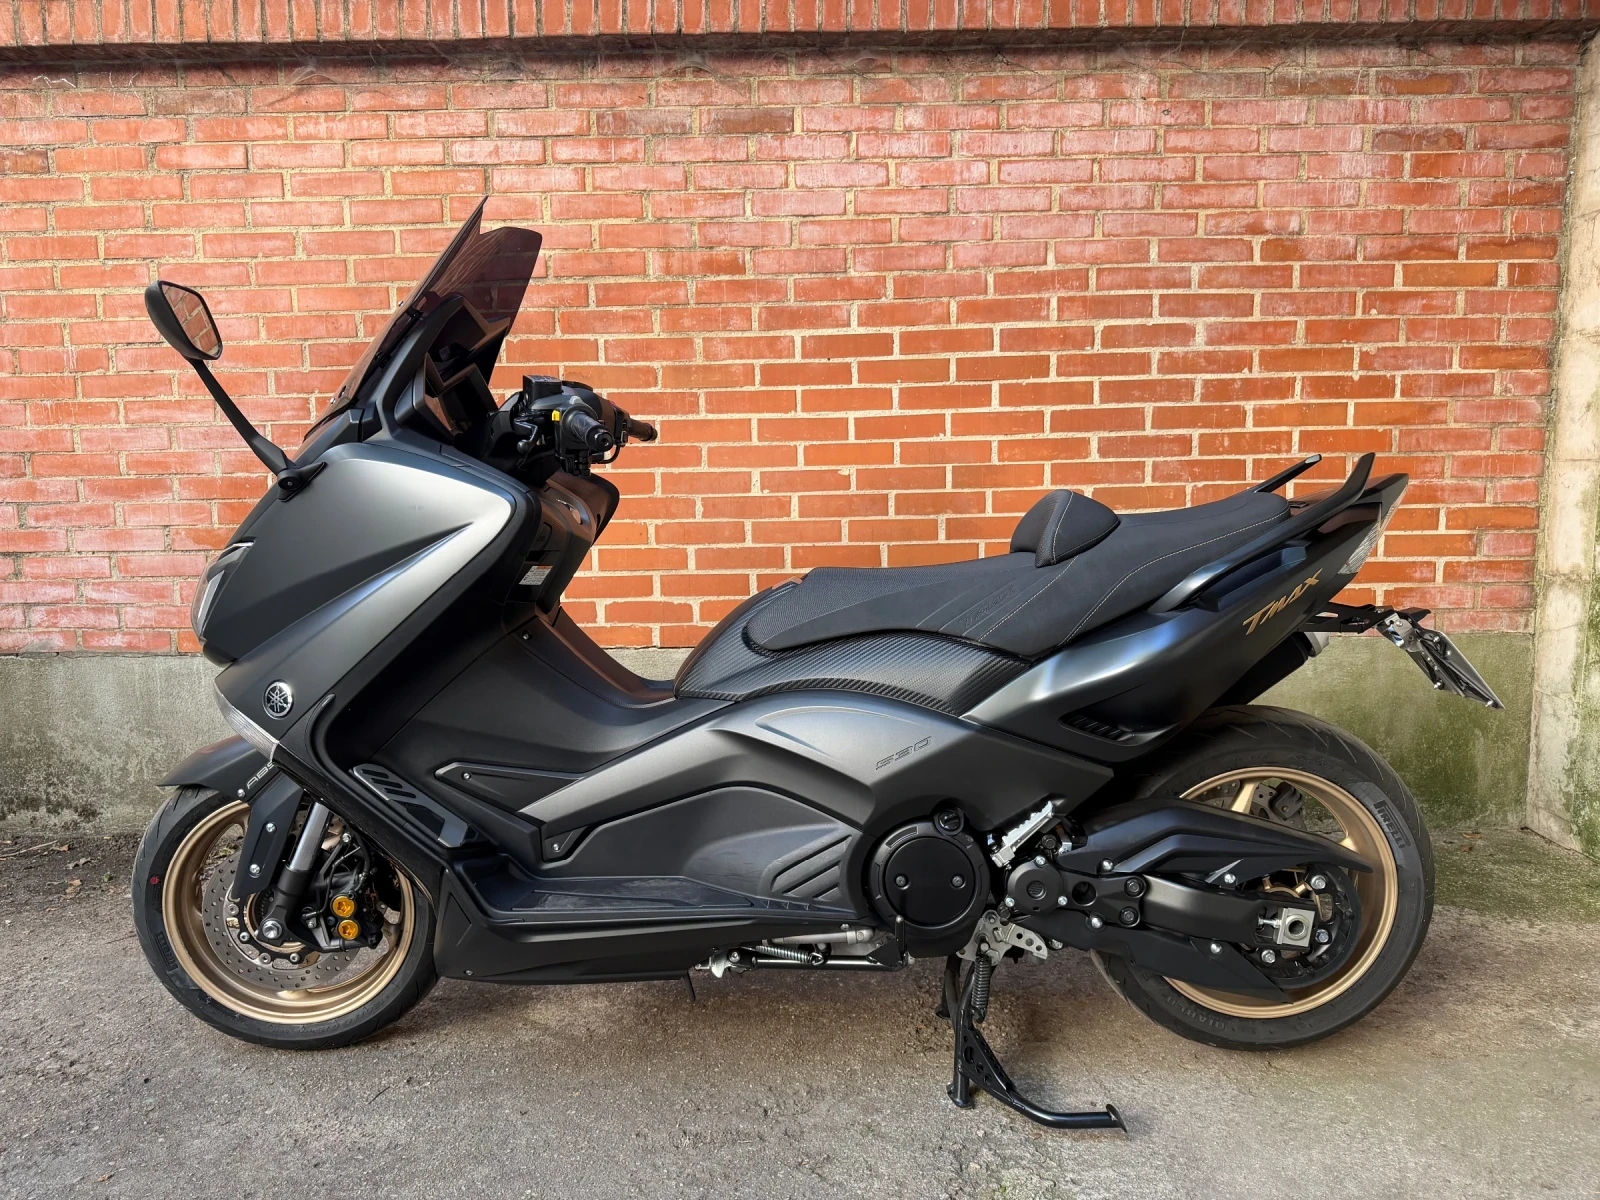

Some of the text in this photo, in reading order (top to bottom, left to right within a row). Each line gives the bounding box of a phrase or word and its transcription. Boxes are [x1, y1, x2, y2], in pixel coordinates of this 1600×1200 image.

[1243, 568, 1323, 636] TMAX
[876, 736, 932, 770] 530
[1373, 800, 1411, 849] PIRELLI
[1167, 996, 1225, 1030] DIABLO
